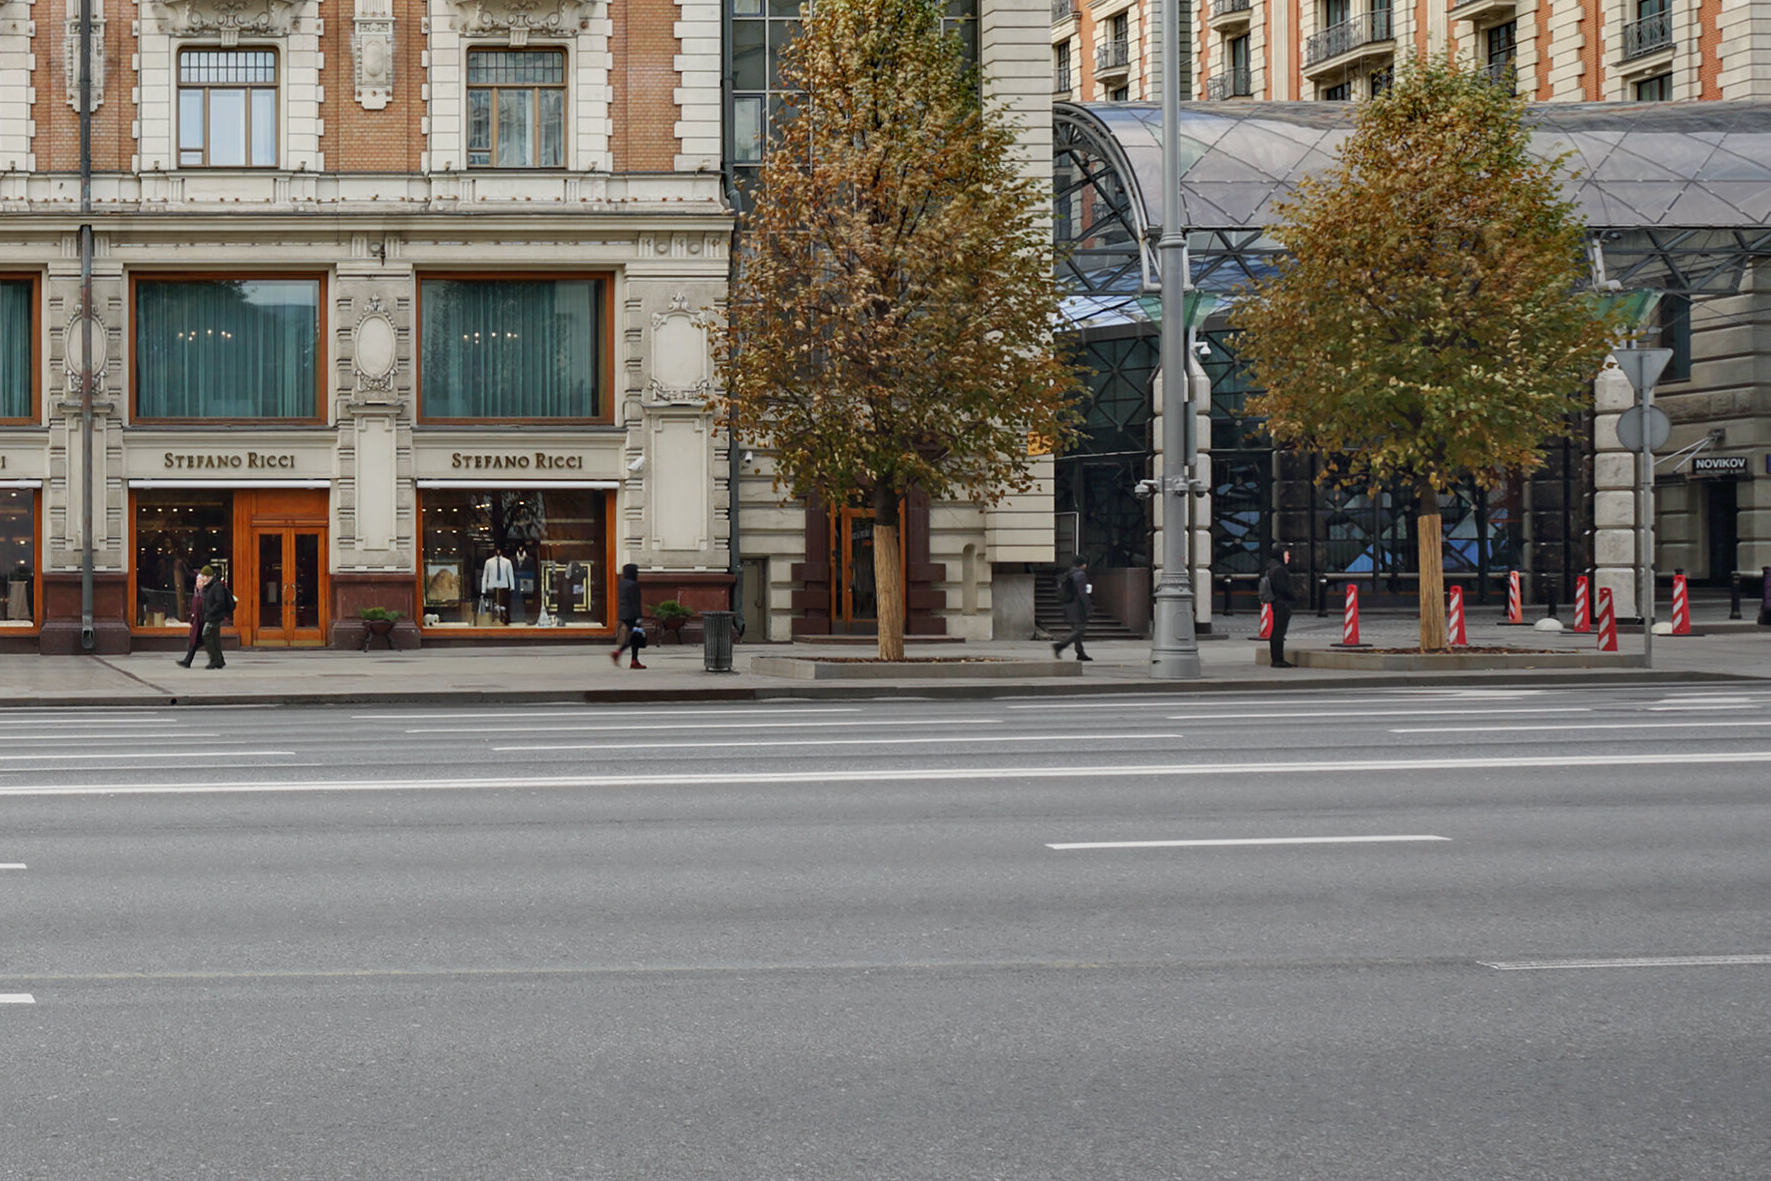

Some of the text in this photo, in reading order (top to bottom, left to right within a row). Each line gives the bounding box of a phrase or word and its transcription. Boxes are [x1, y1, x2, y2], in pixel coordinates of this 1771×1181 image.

[164, 452, 295, 469] STEFANO RICCI
[452, 452, 583, 469] STEFANO RICCI
[1696, 458, 1745, 468] NOVIKOV
